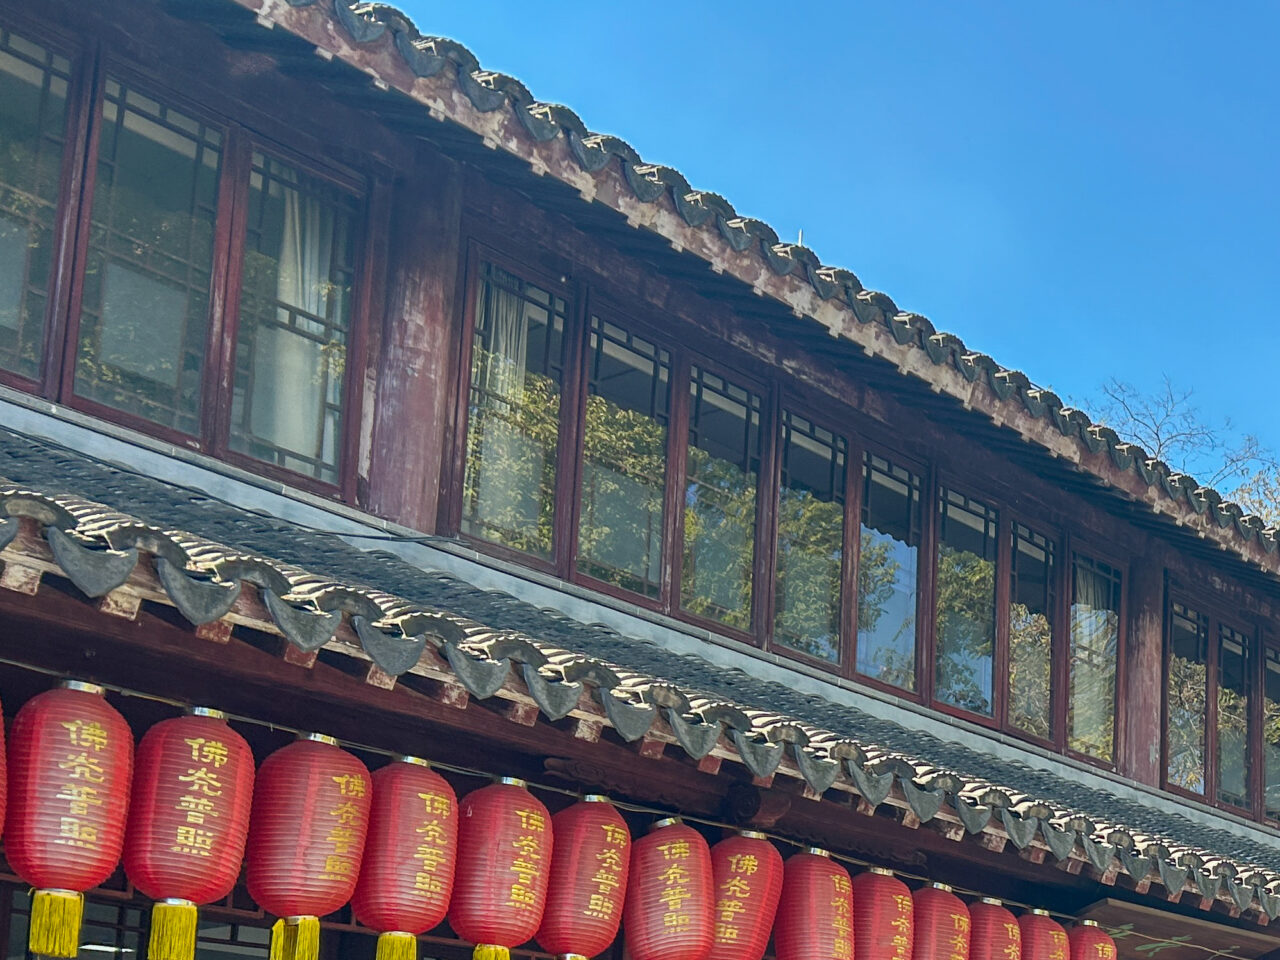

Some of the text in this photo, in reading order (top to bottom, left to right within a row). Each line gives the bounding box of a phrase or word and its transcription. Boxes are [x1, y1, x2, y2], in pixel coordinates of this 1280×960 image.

[54, 719, 108, 851] 佛光普照
[170, 737, 229, 857] 佛光普照
[317, 773, 366, 882] 佛光普照
[414, 791, 451, 899] 佛光普照
[505, 808, 546, 911] 佛光普照
[583, 823, 628, 920] 佛光普照
[656, 839, 692, 934] 佛光普照
[714, 853, 759, 944] 佛光普照
[830, 874, 852, 960] 佛光普照
